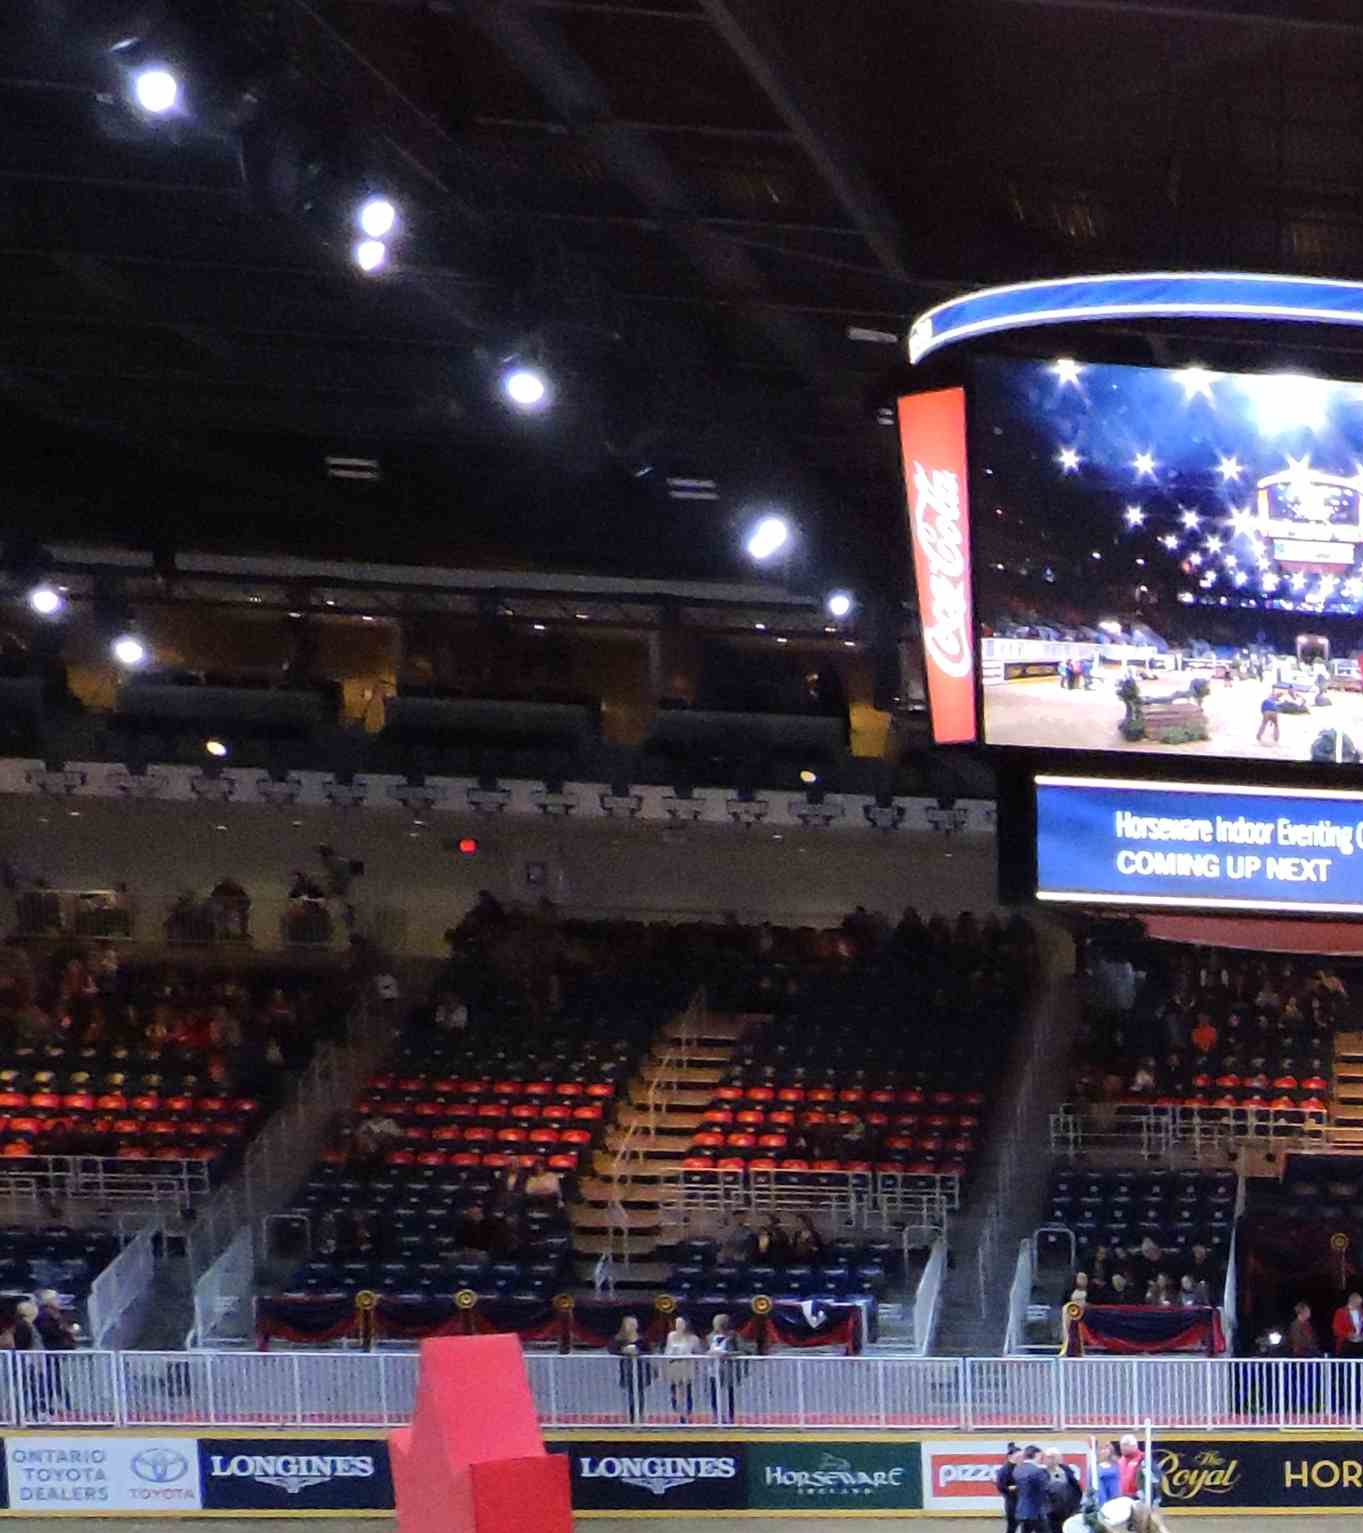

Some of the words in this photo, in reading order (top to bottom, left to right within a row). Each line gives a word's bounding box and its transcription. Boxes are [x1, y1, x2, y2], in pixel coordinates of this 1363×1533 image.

[1115, 810, 1213, 842] Horseware
[1216, 816, 1275, 845] Indoor
[1277, 818, 1354, 855] Eventing
[1117, 850, 1220, 878] COMING
[1226, 855, 1262, 879] UP
[1266, 857, 1332, 882] NEXT
[12, 1450, 105, 1463] ONTARIO
[211, 1455, 375, 1477] LONGINES
[24, 1468, 106, 1482] TOYOTA
[580, 1457, 736, 1477] LONGINES
[1152, 1449, 1241, 1500] Royal
[19, 1487, 109, 1501] DEALERS
[129, 1488, 195, 1499] TOYOTA
